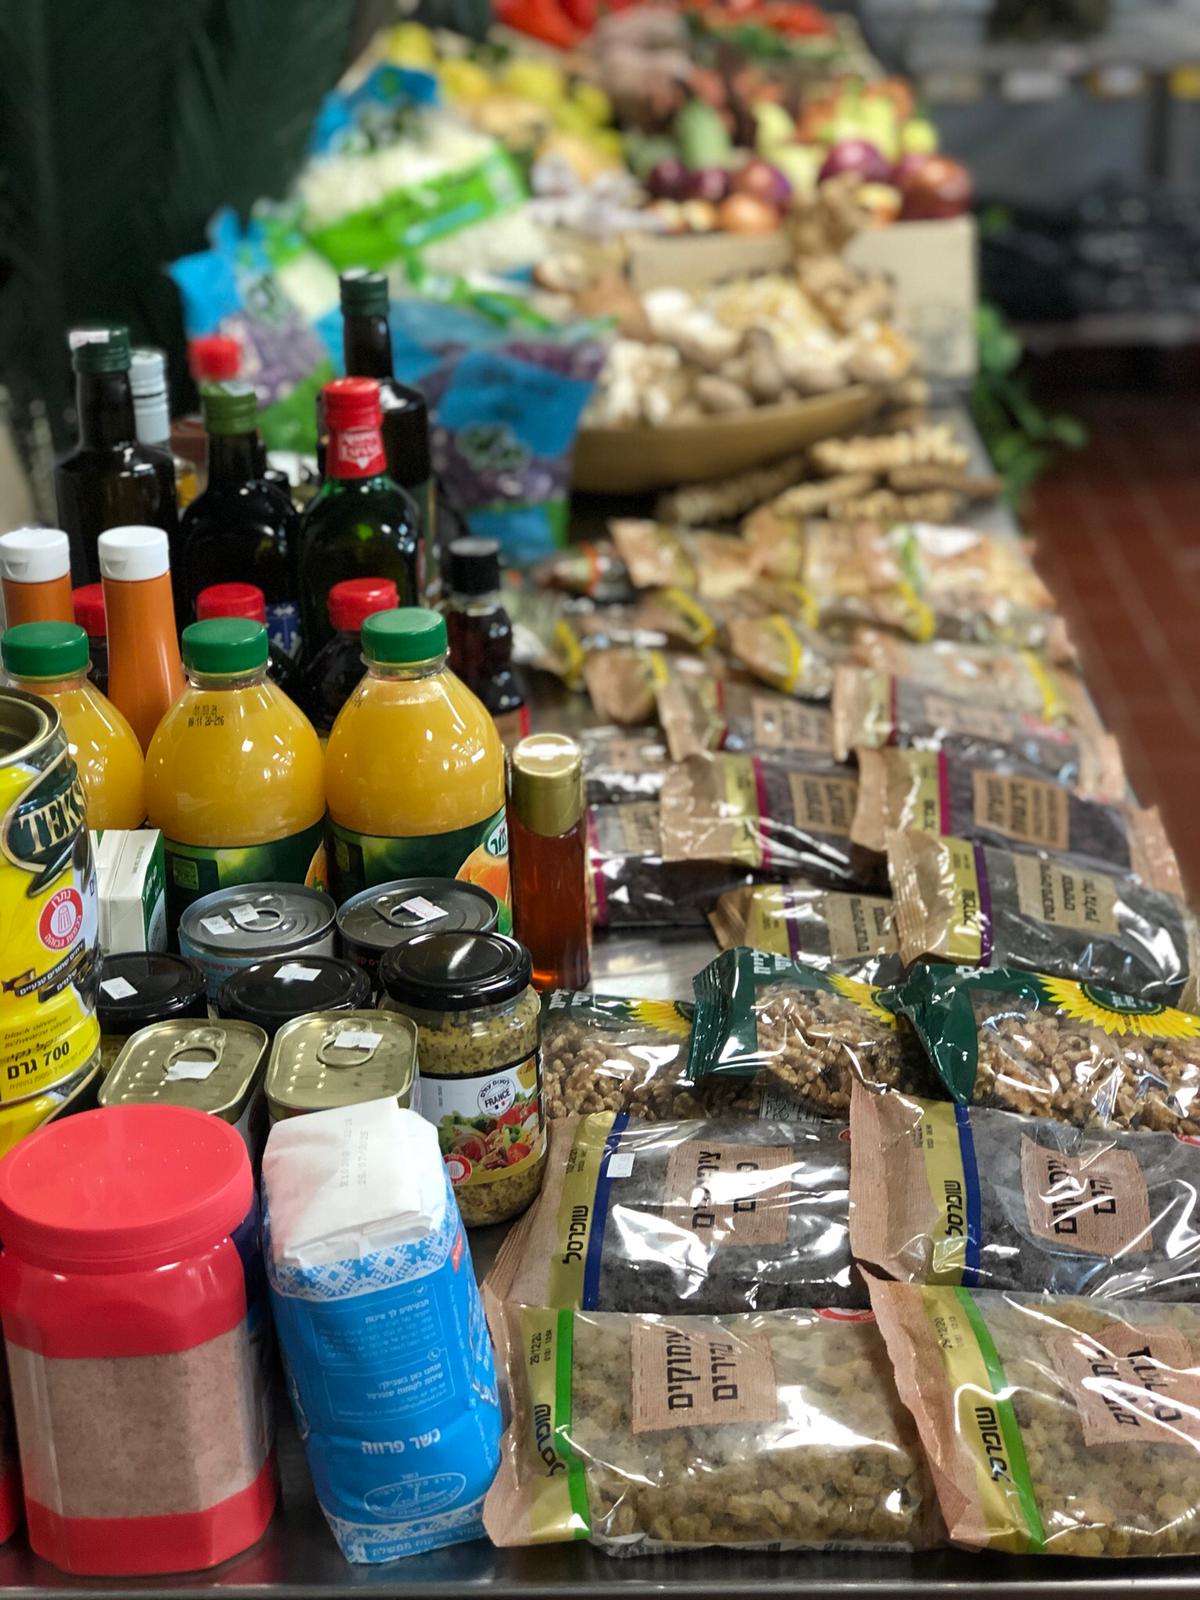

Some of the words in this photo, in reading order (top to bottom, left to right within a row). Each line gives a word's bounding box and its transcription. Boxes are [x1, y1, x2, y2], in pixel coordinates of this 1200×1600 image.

[20, 977, 47, 995] טבעיים
[43, 1041, 70, 1066] 700
[7, 1058, 38, 1080] גרם
[484, 1088, 511, 1108] FRANCE
[944, 1180, 964, 1237] שופרסל
[562, 1206, 589, 1264] שופרסל
[665, 1330, 700, 1410] צימוקים
[361, 1441, 405, 1455] פרווה
[409, 1428, 441, 1449] כשר
[534, 1404, 565, 1478] שופרסל
[974, 1406, 1011, 1483] שופרסל
